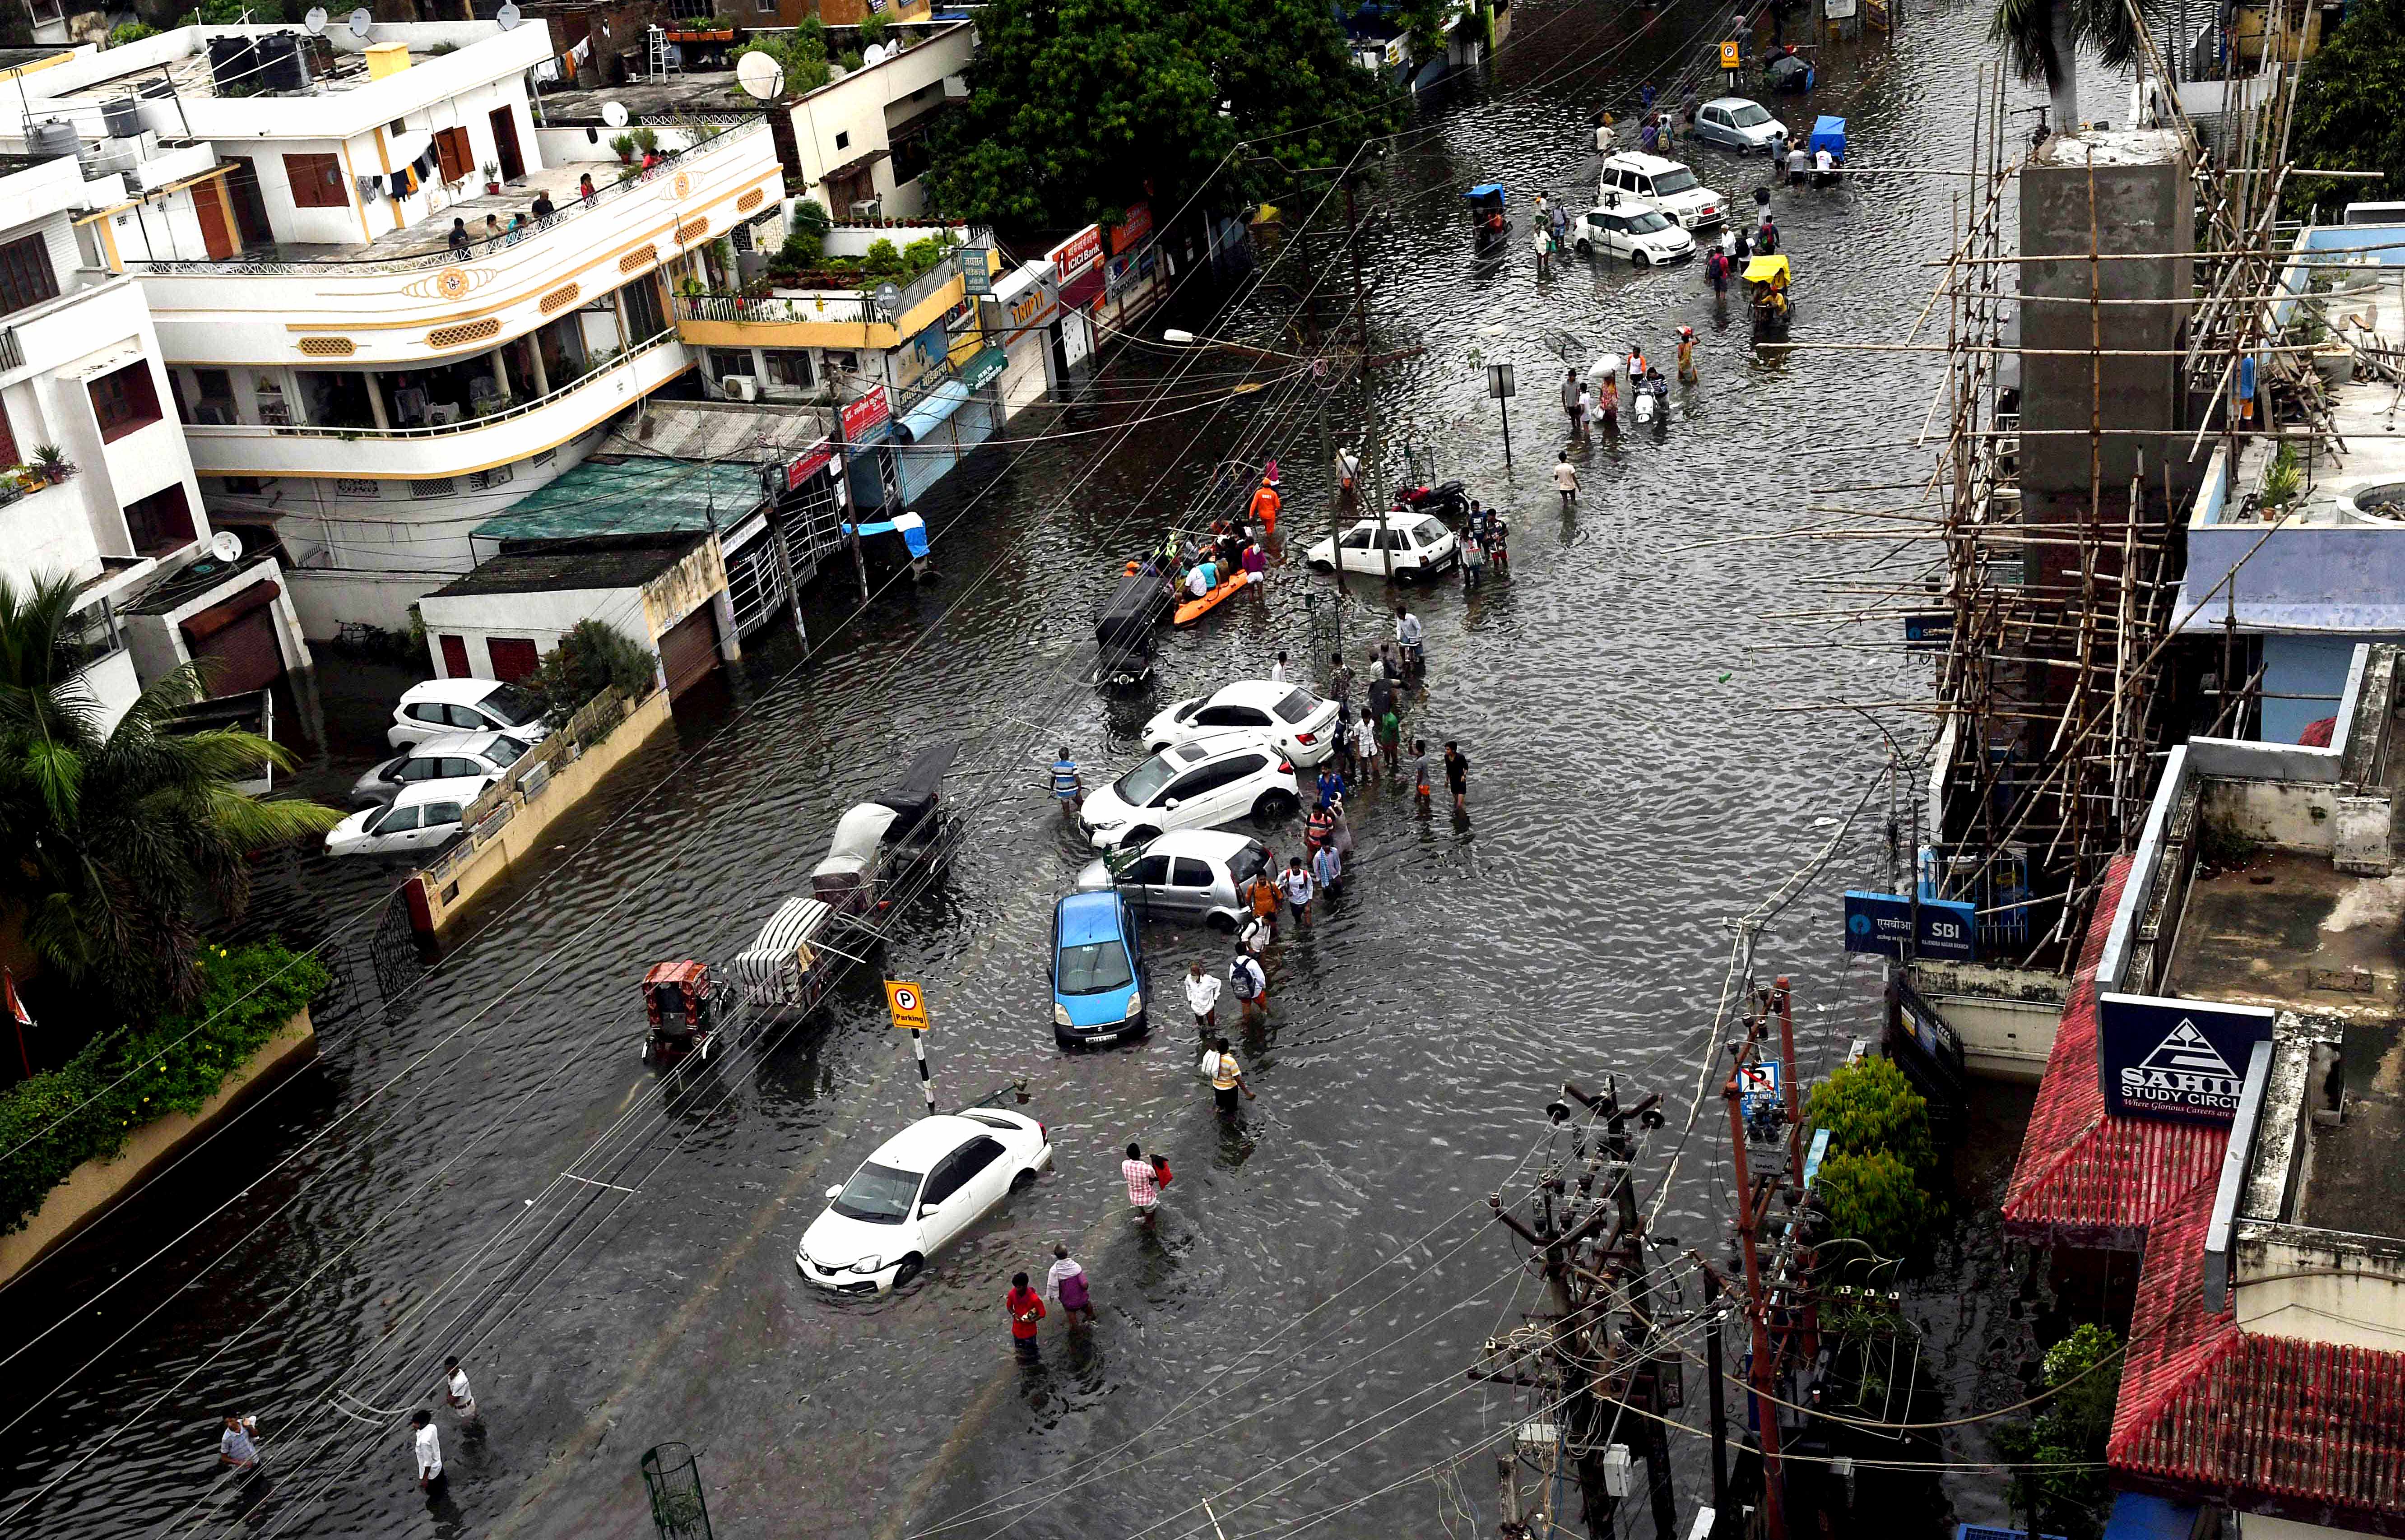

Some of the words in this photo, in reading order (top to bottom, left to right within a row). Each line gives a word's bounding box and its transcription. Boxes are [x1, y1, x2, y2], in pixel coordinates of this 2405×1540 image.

[1068, 254, 1083, 271] ICICI
[1084, 243, 1100, 260] Bank
[1012, 290, 1045, 327] TRIPTI
[1876, 918, 1912, 930] एसबीआ
[1932, 922, 1959, 939] SBI
[900, 993, 911, 1006] P
[896, 1014, 924, 1024] Parking
[2121, 1085, 2182, 1102] STUDY
[2123, 1099, 2149, 1108] Where
[2151, 1102, 2185, 1112] Glorious
[2186, 1106, 2215, 1115] Careers
